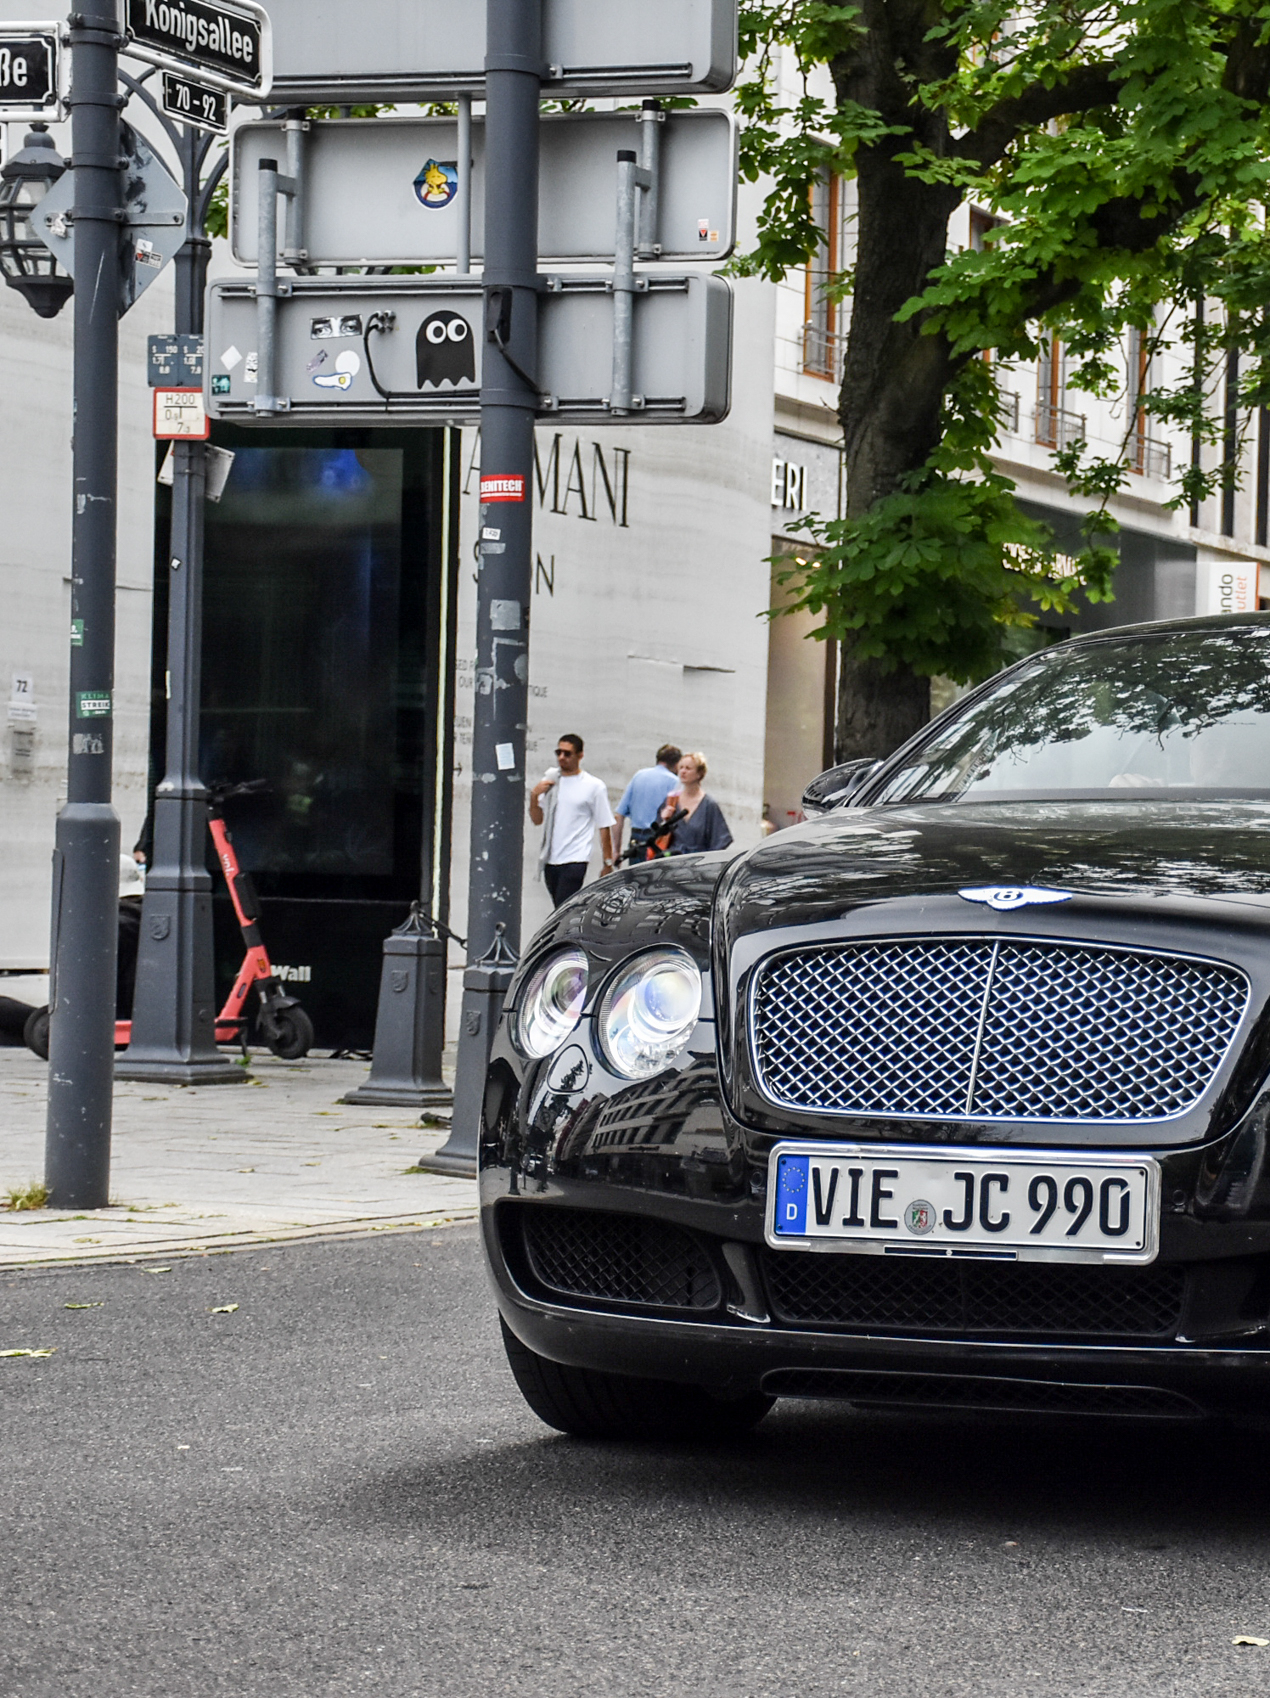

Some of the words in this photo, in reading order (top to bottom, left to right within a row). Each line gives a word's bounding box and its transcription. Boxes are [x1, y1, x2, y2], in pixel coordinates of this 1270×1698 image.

[145, 0, 254, 63] Königsallee
[175, 83, 191, 111] 70
[201, 93, 217, 122] 92
[16, 679, 28, 693] 72
[81, 701, 110, 709] STREIK
[270, 964, 311, 982] Wall
[812, 1166, 899, 1229] VIE
[943, 1172, 1010, 1232] JC
[1028, 1175, 1130, 1237] 990
[786, 1203, 798, 1220] D
